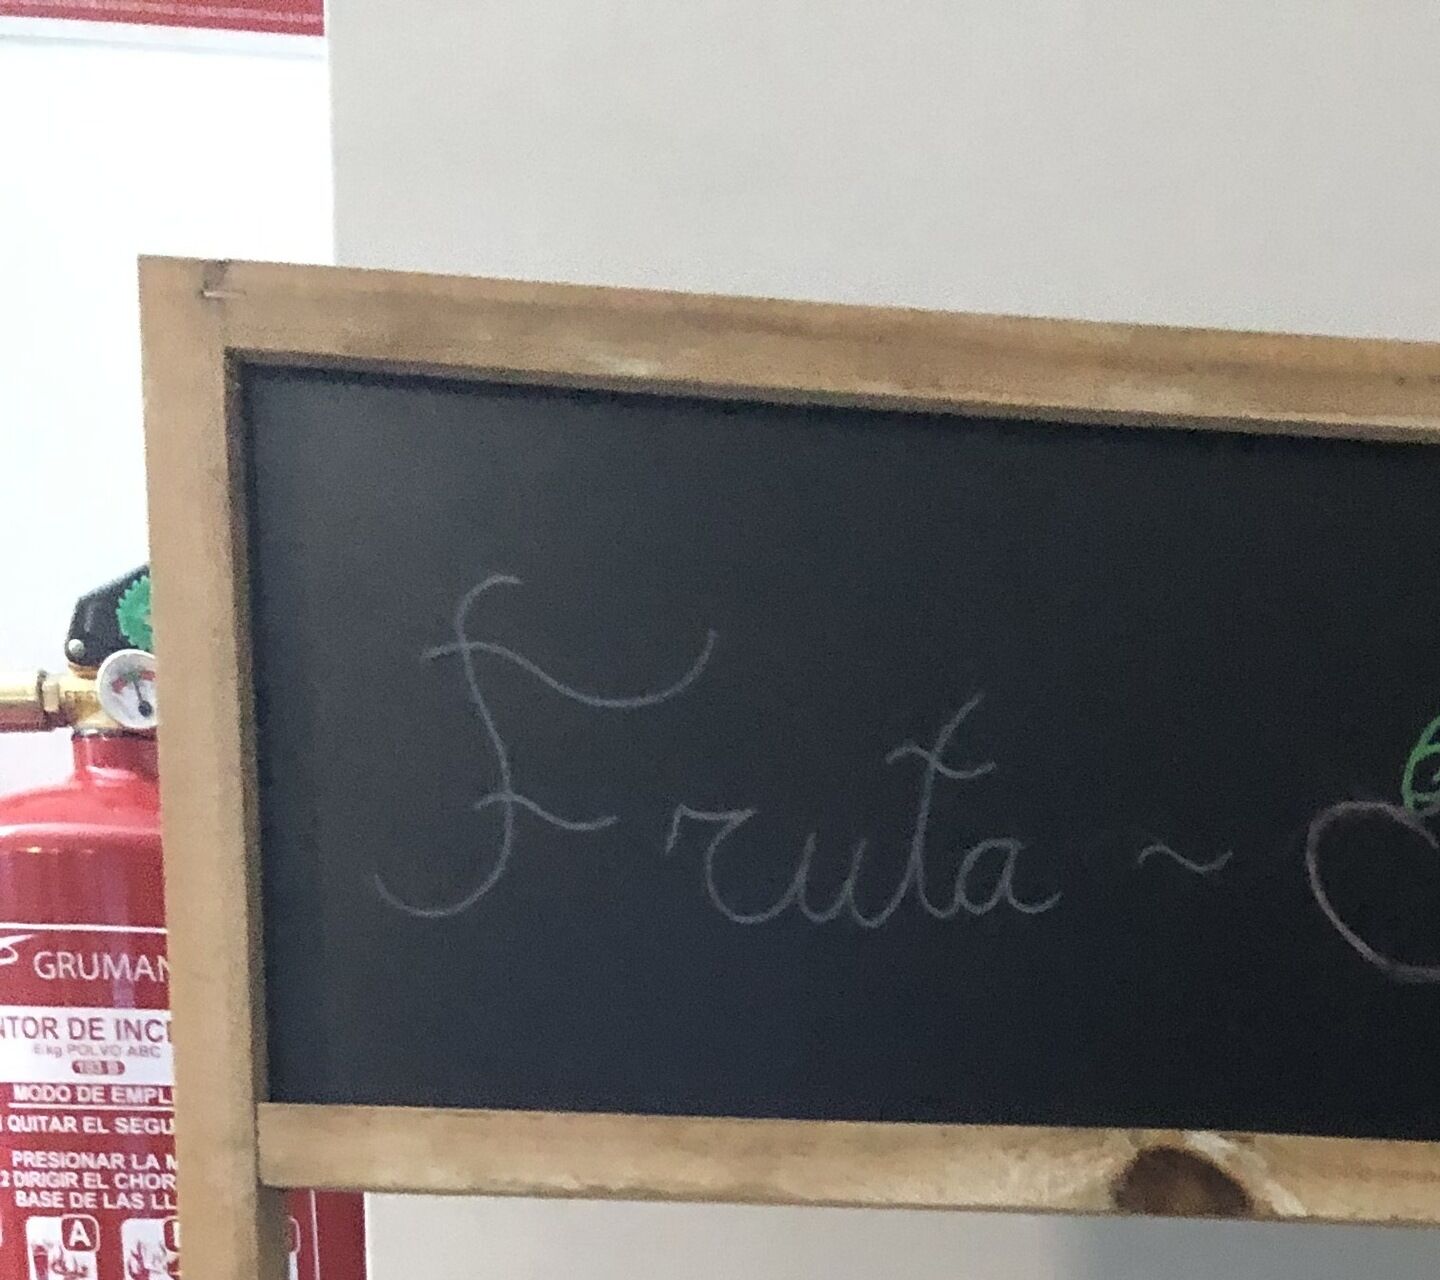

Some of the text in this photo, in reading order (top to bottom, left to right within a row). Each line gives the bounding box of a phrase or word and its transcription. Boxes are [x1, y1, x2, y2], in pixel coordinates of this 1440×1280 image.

[374, 572, 1062, 928] Fruta
[68, 1018, 105, 1041] DE
[67, 1044, 122, 1056] POLVO
[127, 1046, 161, 1058] ABC
[13, 1084, 71, 1102] MODO
[77, 1086, 106, 1103] DE
[7, 1115, 78, 1133] QUITAR
[83, 1117, 110, 1134] EL
[12, 1151, 125, 1170] PRESIONAR
[131, 1154, 161, 1170] LA
[13, 1171, 79, 1189] DIRIGIR
[83, 1172, 110, 1189] EL
[15, 1191, 65, 1208] BASE
[69, 1192, 98, 1209] DE
[103, 1192, 145, 1209] LAS
[69, 1219, 92, 1247] A
